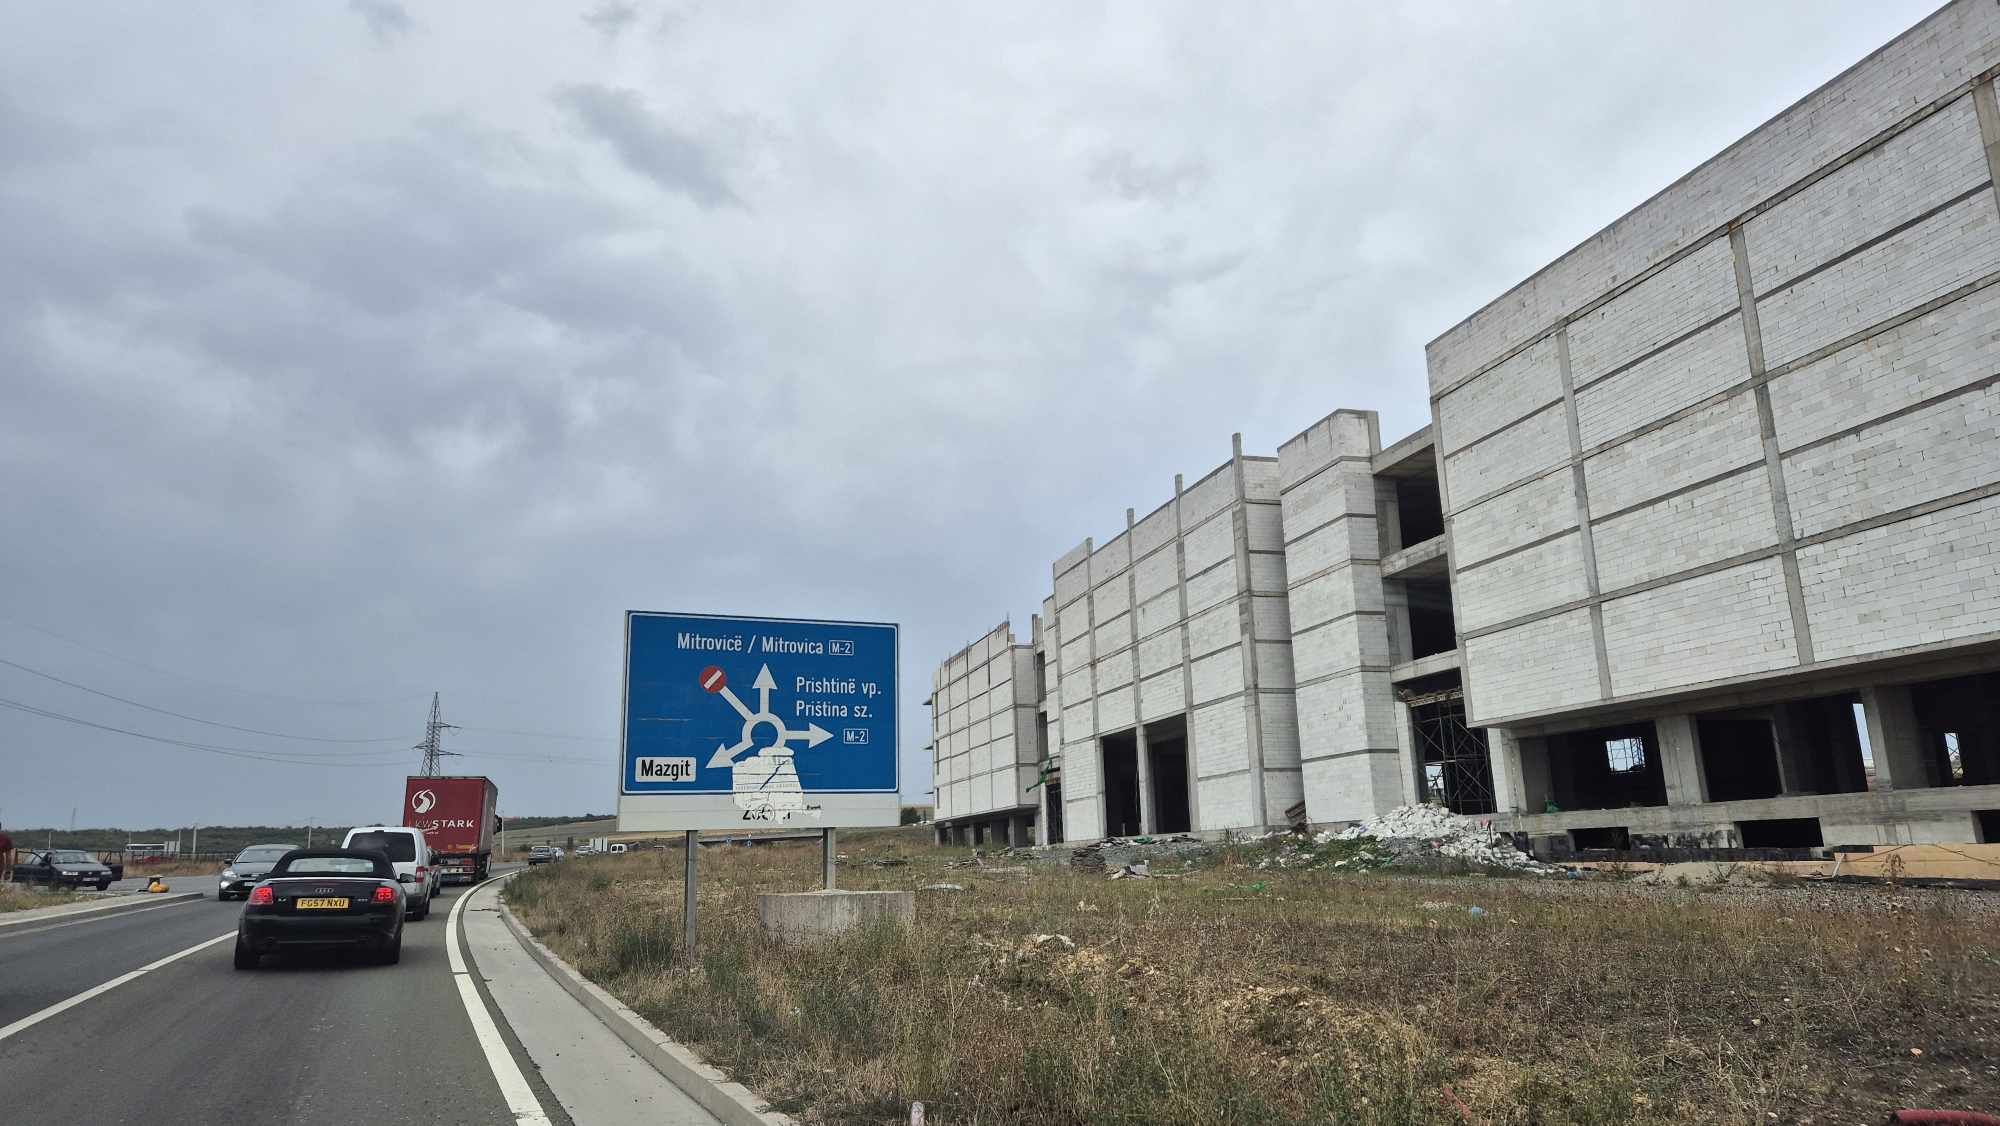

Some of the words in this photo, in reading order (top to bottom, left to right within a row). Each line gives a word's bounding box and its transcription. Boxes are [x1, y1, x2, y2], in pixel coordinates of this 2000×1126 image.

[677, 632, 743, 651] Mitrovicë
[748, 634, 757, 654] /
[762, 636, 824, 654] Mitrovica
[831, 641, 852, 654] M-2
[796, 676, 856, 694] Prishtinë
[861, 682, 881, 699] vp.
[796, 700, 848, 717] Priština
[854, 705, 873, 718] sz.
[845, 729, 867, 743] M-2
[640, 759, 691, 780] Mazgit
